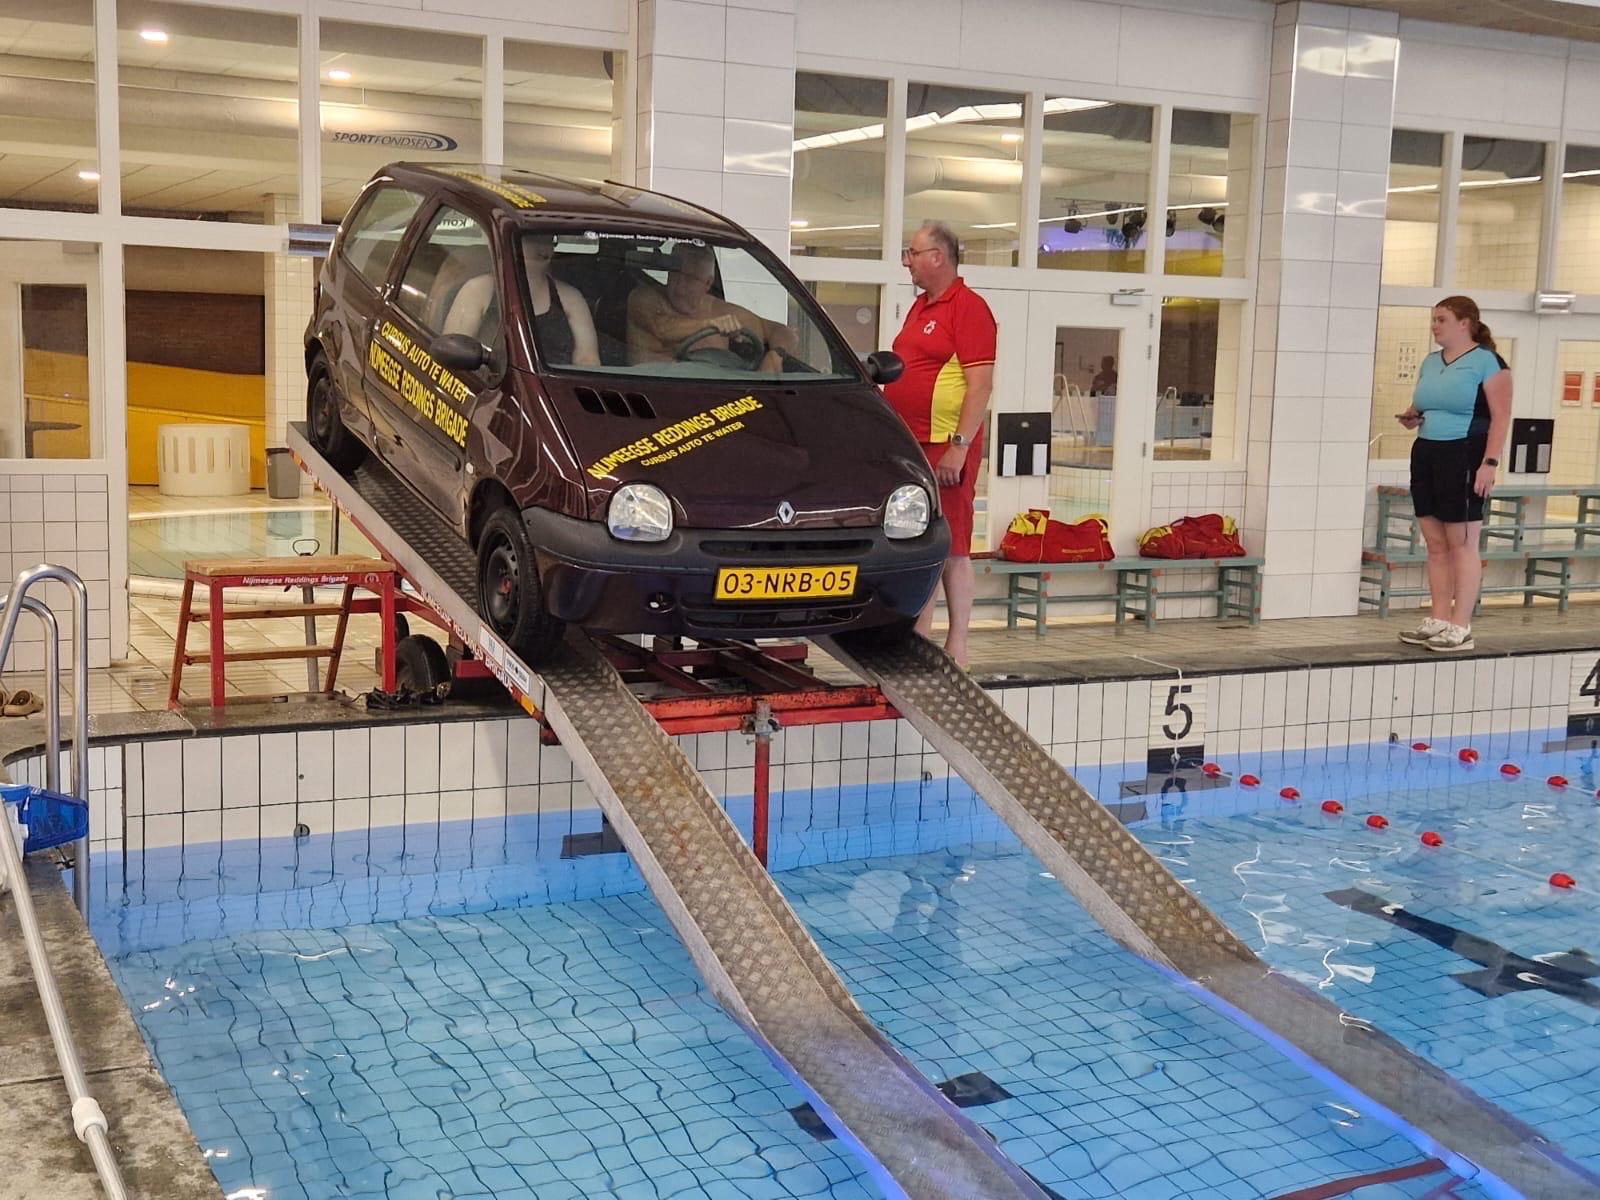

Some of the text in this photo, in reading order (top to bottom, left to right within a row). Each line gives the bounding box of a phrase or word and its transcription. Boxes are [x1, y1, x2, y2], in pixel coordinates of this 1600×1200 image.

[332, 132, 433, 149] SPORTFONDSEN
[407, 344, 431, 371] AUTO
[429, 361, 441, 380] TE
[438, 370, 470, 404] WATER
[401, 369, 435, 419] REDDINGS
[434, 398, 469, 447] BRIGADE
[586, 395, 763, 480] NIJMEEGSE REDDINGS BRIGADE
[640, 421, 745, 467] CURSUS AUTO TE WATER
[242, 574, 349, 585] Nijmeegse Reddings Brigade
[724, 571, 851, 594] 03-NRB-05
[1579, 657, 1600, 707] 4
[1162, 684, 1193, 740] 5
